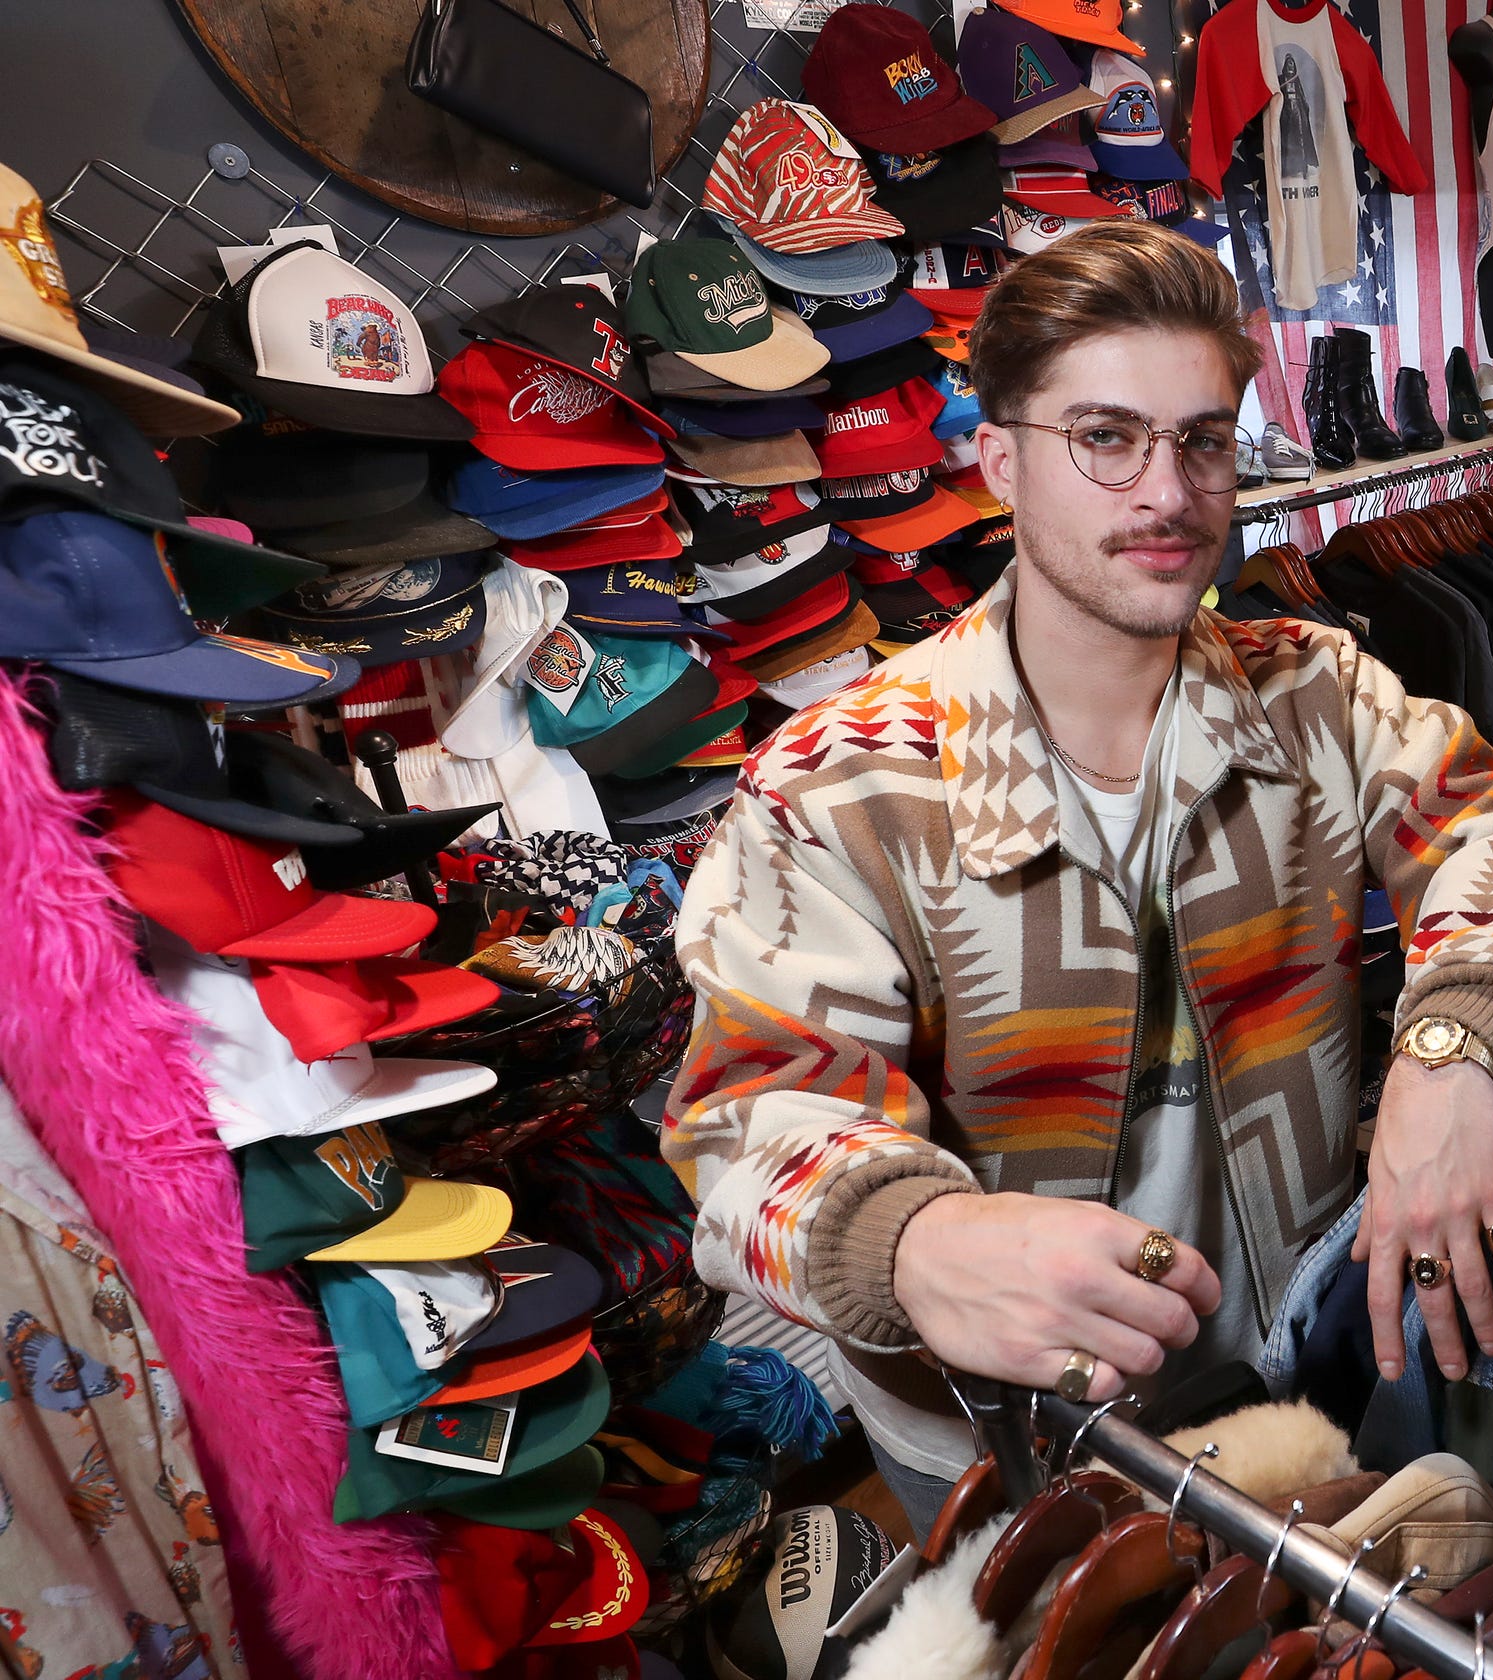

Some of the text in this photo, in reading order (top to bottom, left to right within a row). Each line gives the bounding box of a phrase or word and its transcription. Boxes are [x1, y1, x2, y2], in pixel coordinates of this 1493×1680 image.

[1041, 216, 1066, 232] REDS
[823, 405, 890, 437] Marlboro
[646, 823, 700, 844] CARDINALS
[781, 1509, 811, 1610] Wilson
